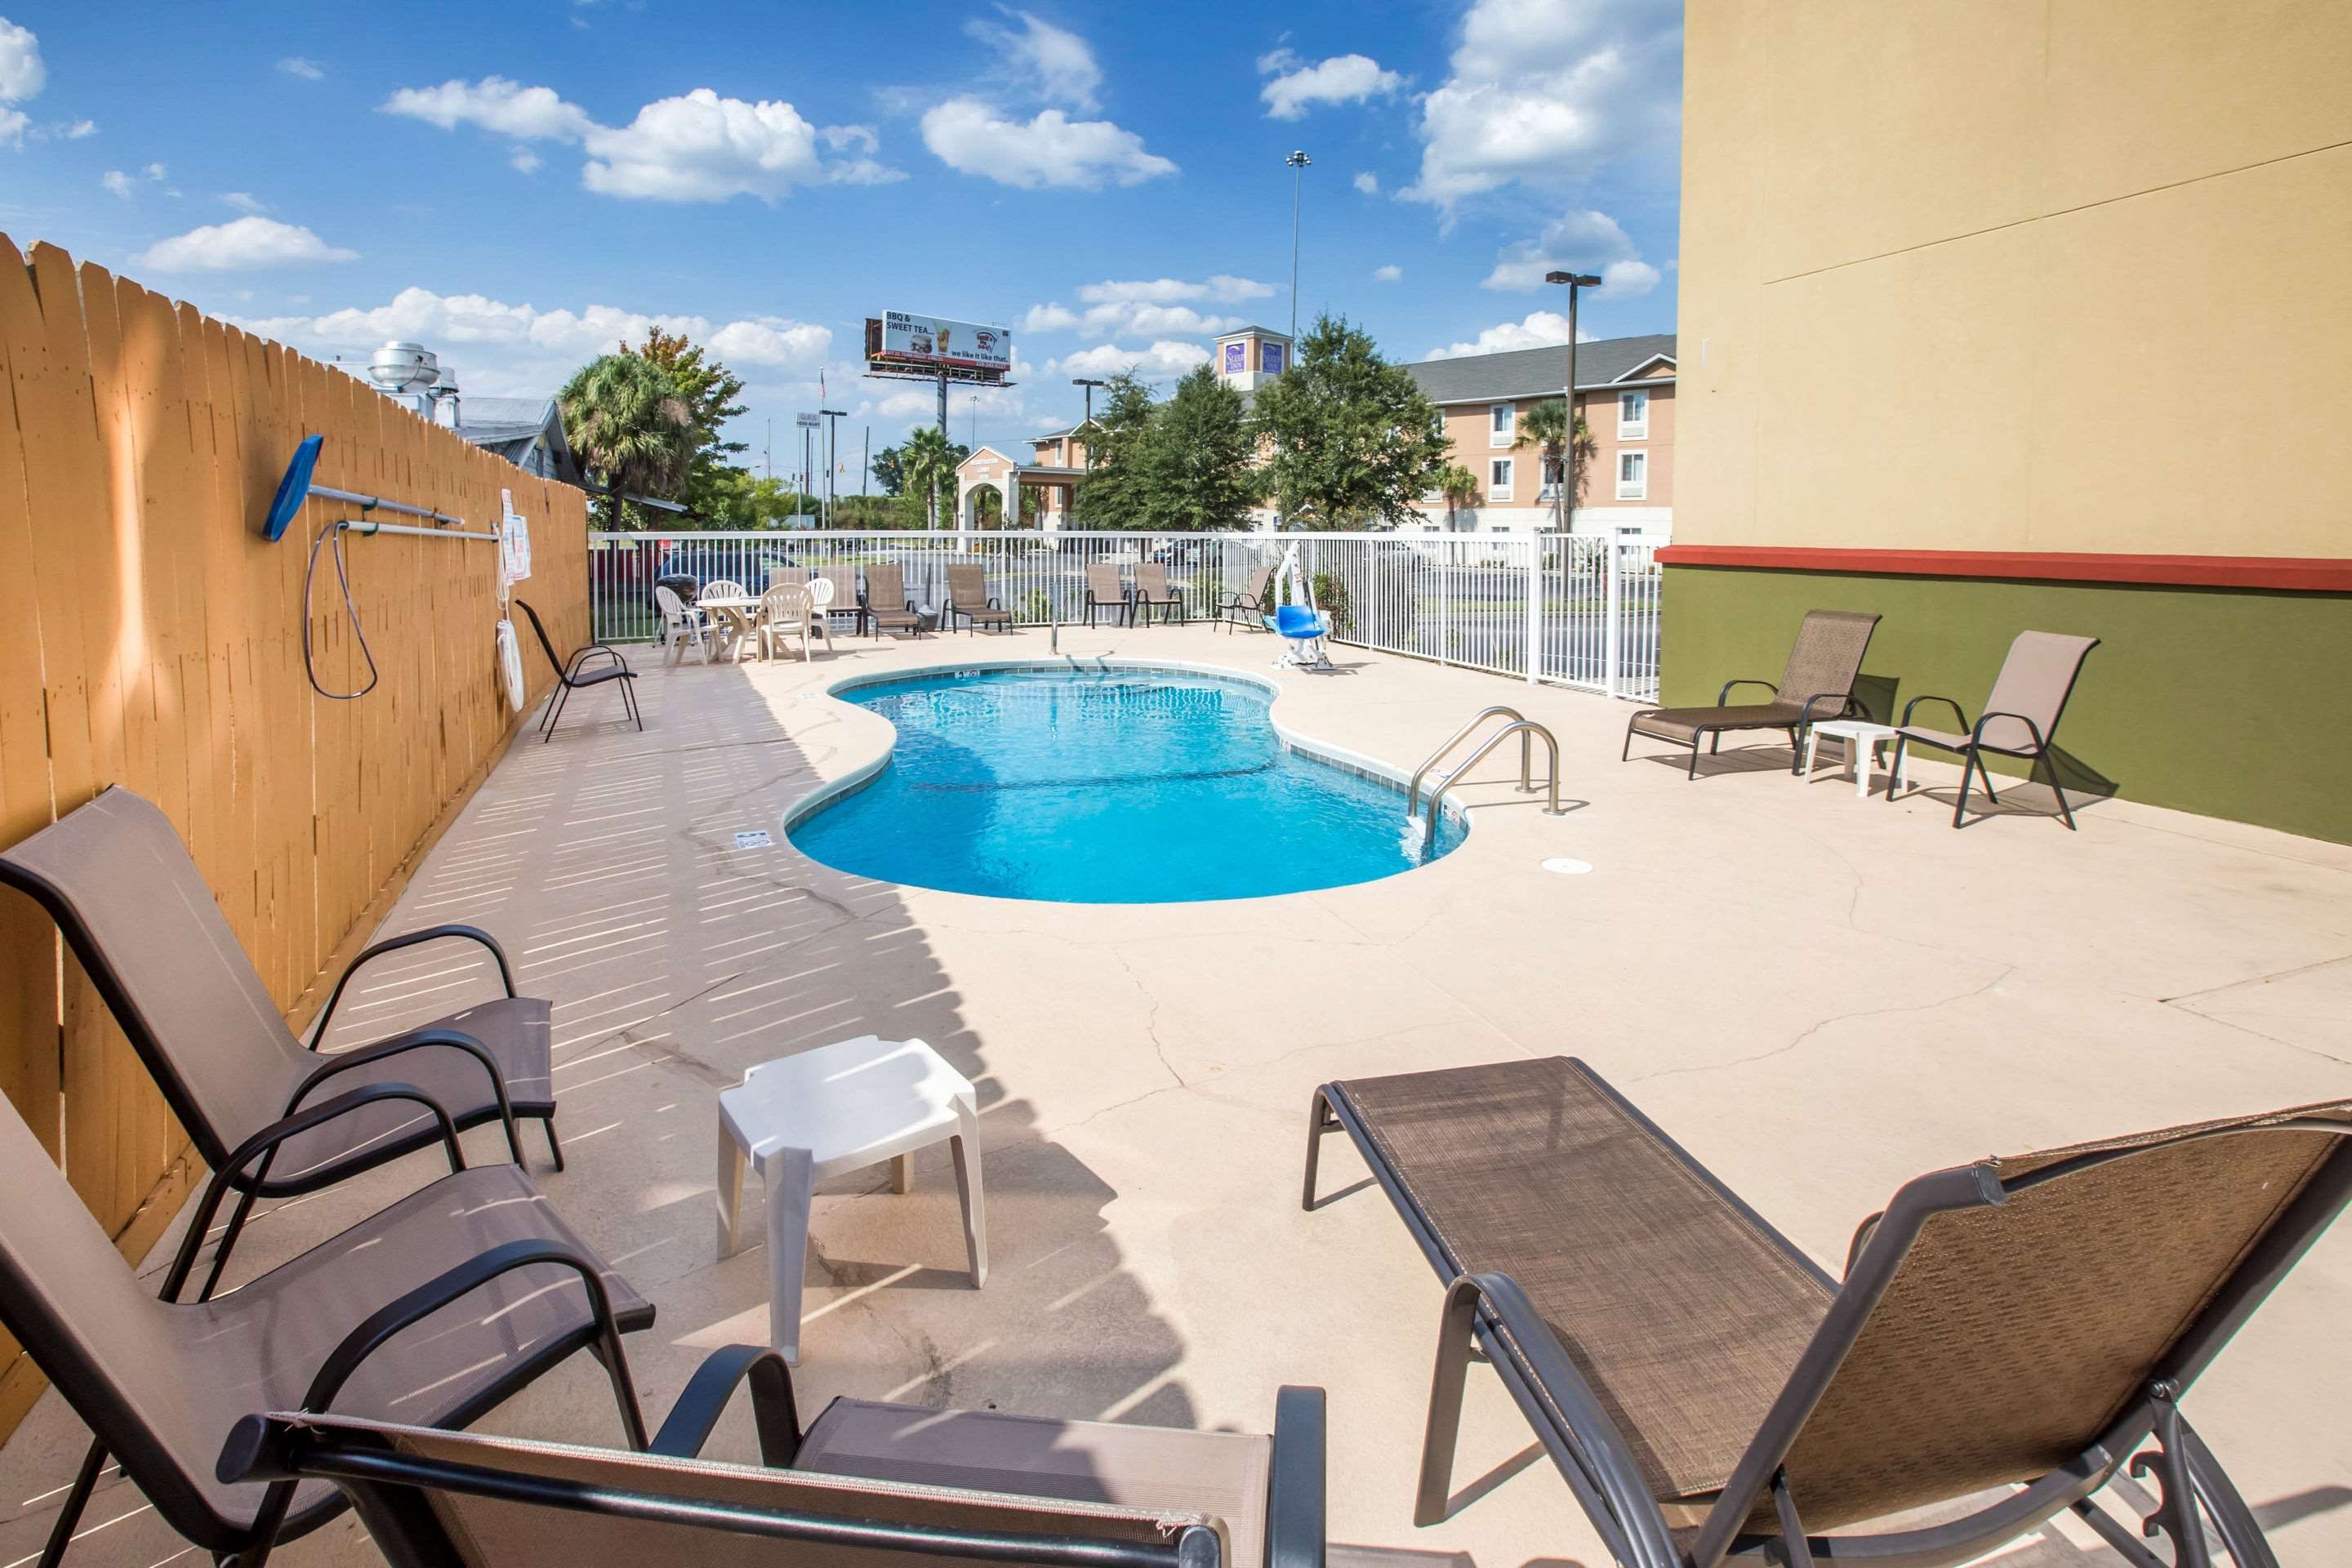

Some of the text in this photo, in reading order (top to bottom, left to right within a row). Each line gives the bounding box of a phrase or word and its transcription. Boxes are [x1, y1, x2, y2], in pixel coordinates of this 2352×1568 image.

[886, 311, 903, 322] BBQ
[887, 321, 912, 332] SWEET
[962, 350, 973, 359] like
